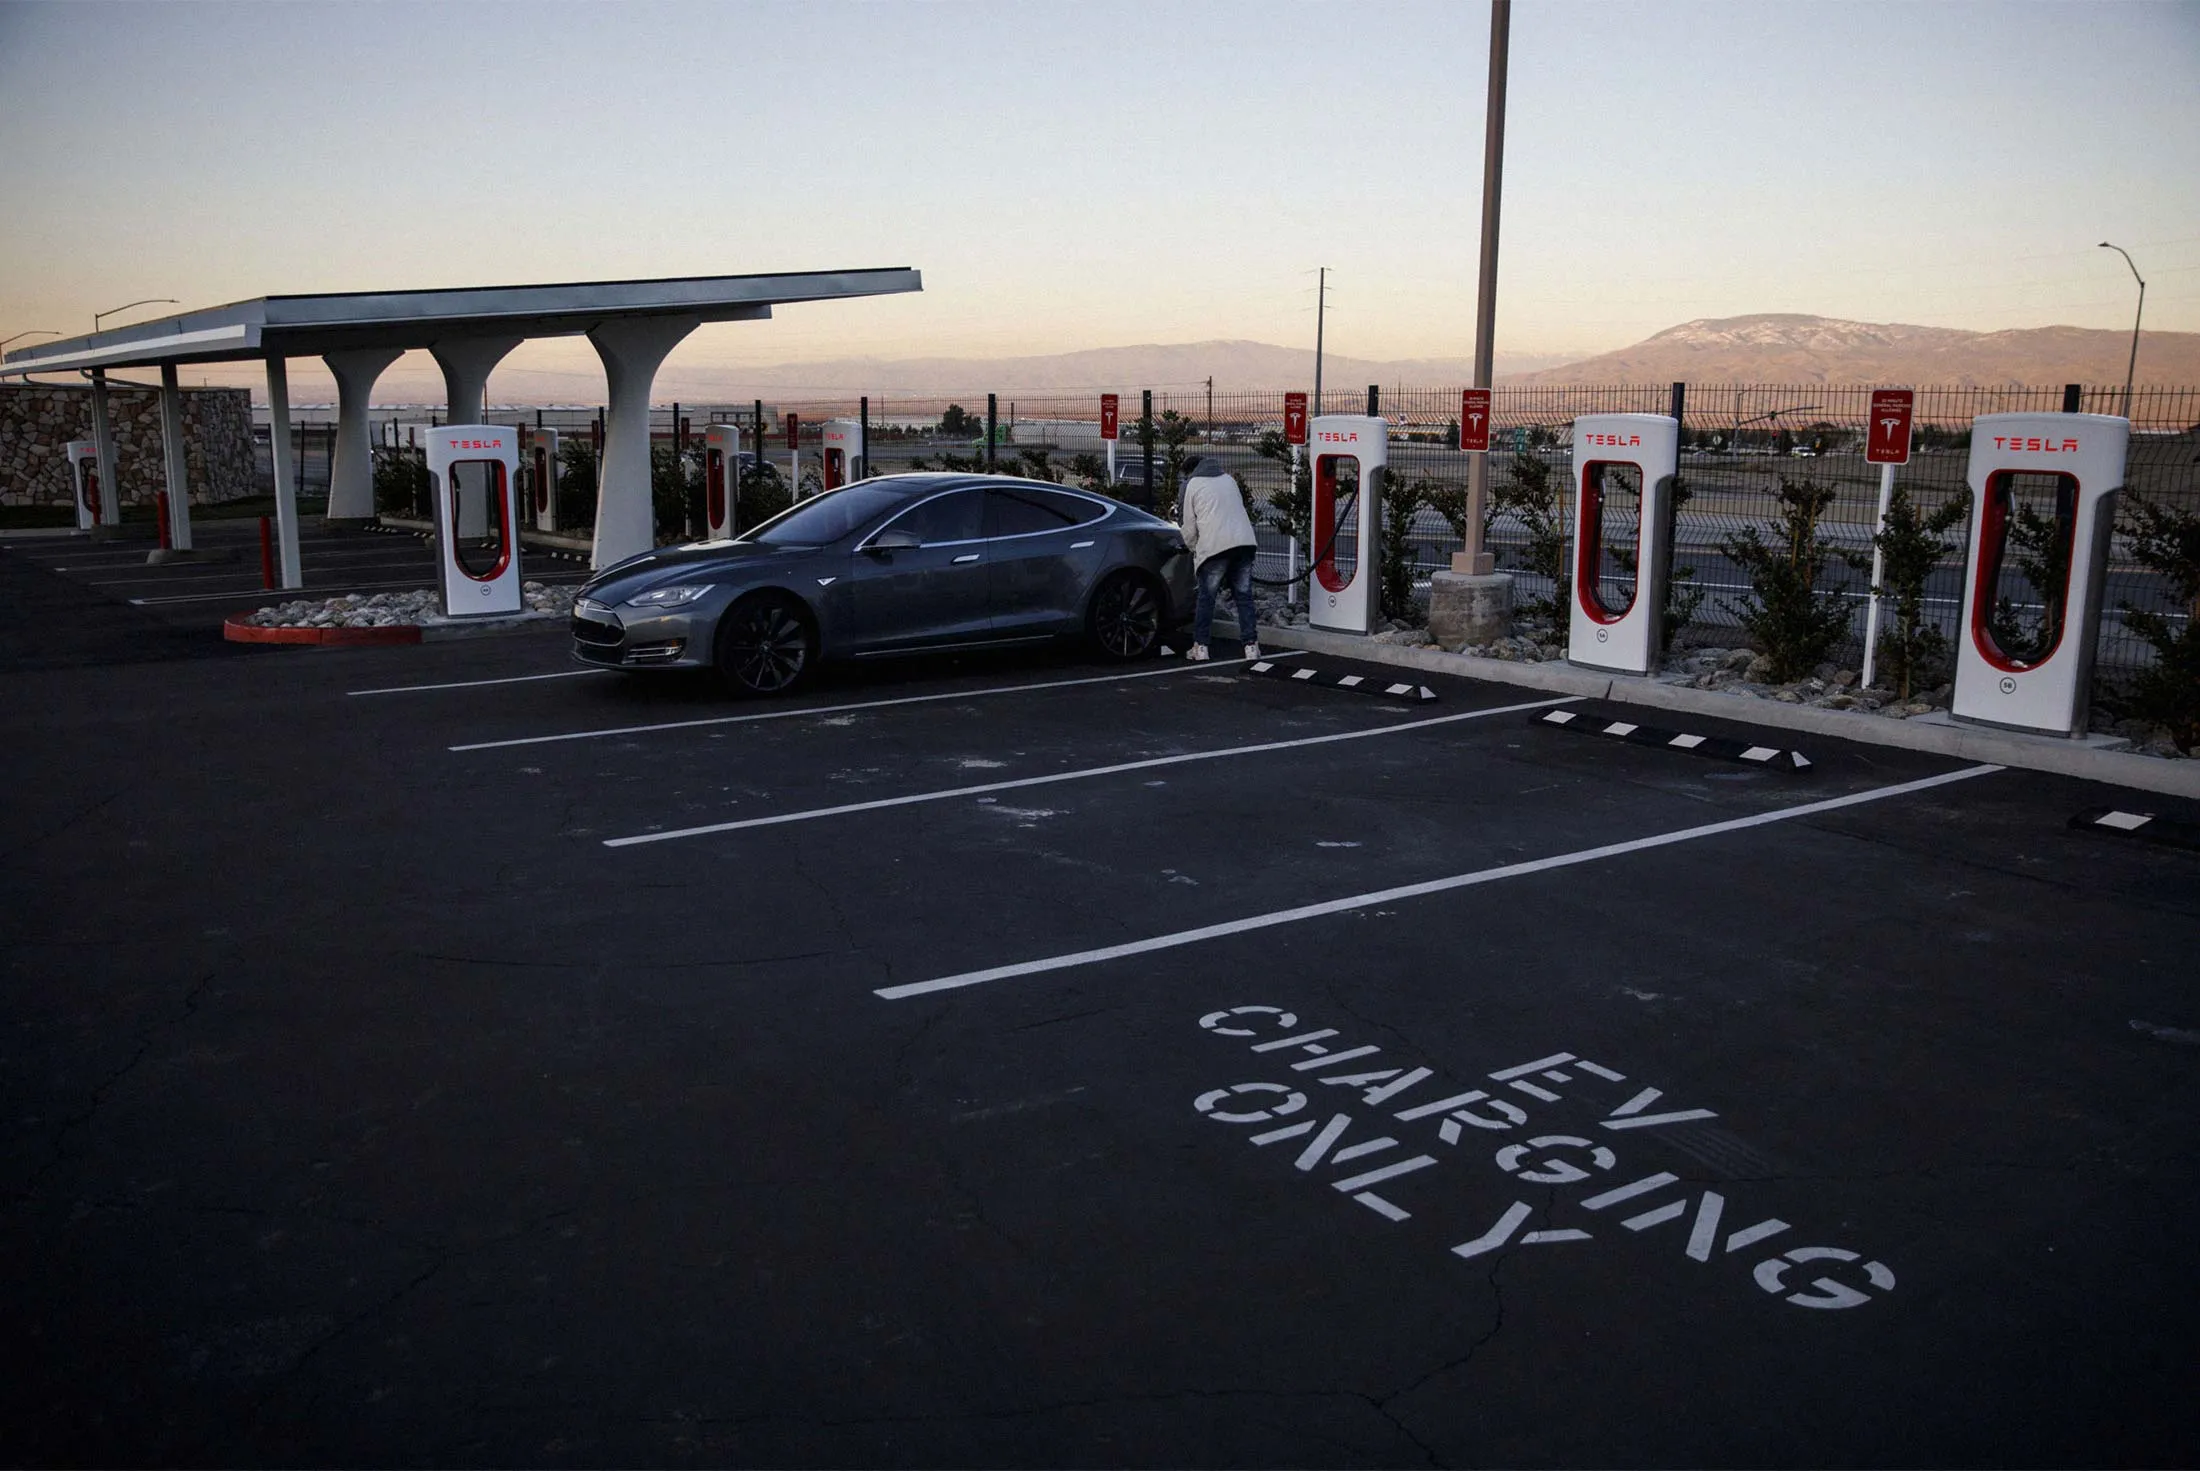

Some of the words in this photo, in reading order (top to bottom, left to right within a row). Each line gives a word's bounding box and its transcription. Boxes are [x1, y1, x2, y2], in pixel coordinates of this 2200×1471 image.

[449, 440, 502, 449] TESLA
[1318, 432, 1357, 442] TESLA
[1586, 434, 1640, 446] TESLA
[1993, 437, 2078, 452] TESLA
[1488, 1052, 1719, 1130] EV
[1198, 1005, 1896, 1309] CHARGING
[1194, 1082, 1593, 1258] ONLY
